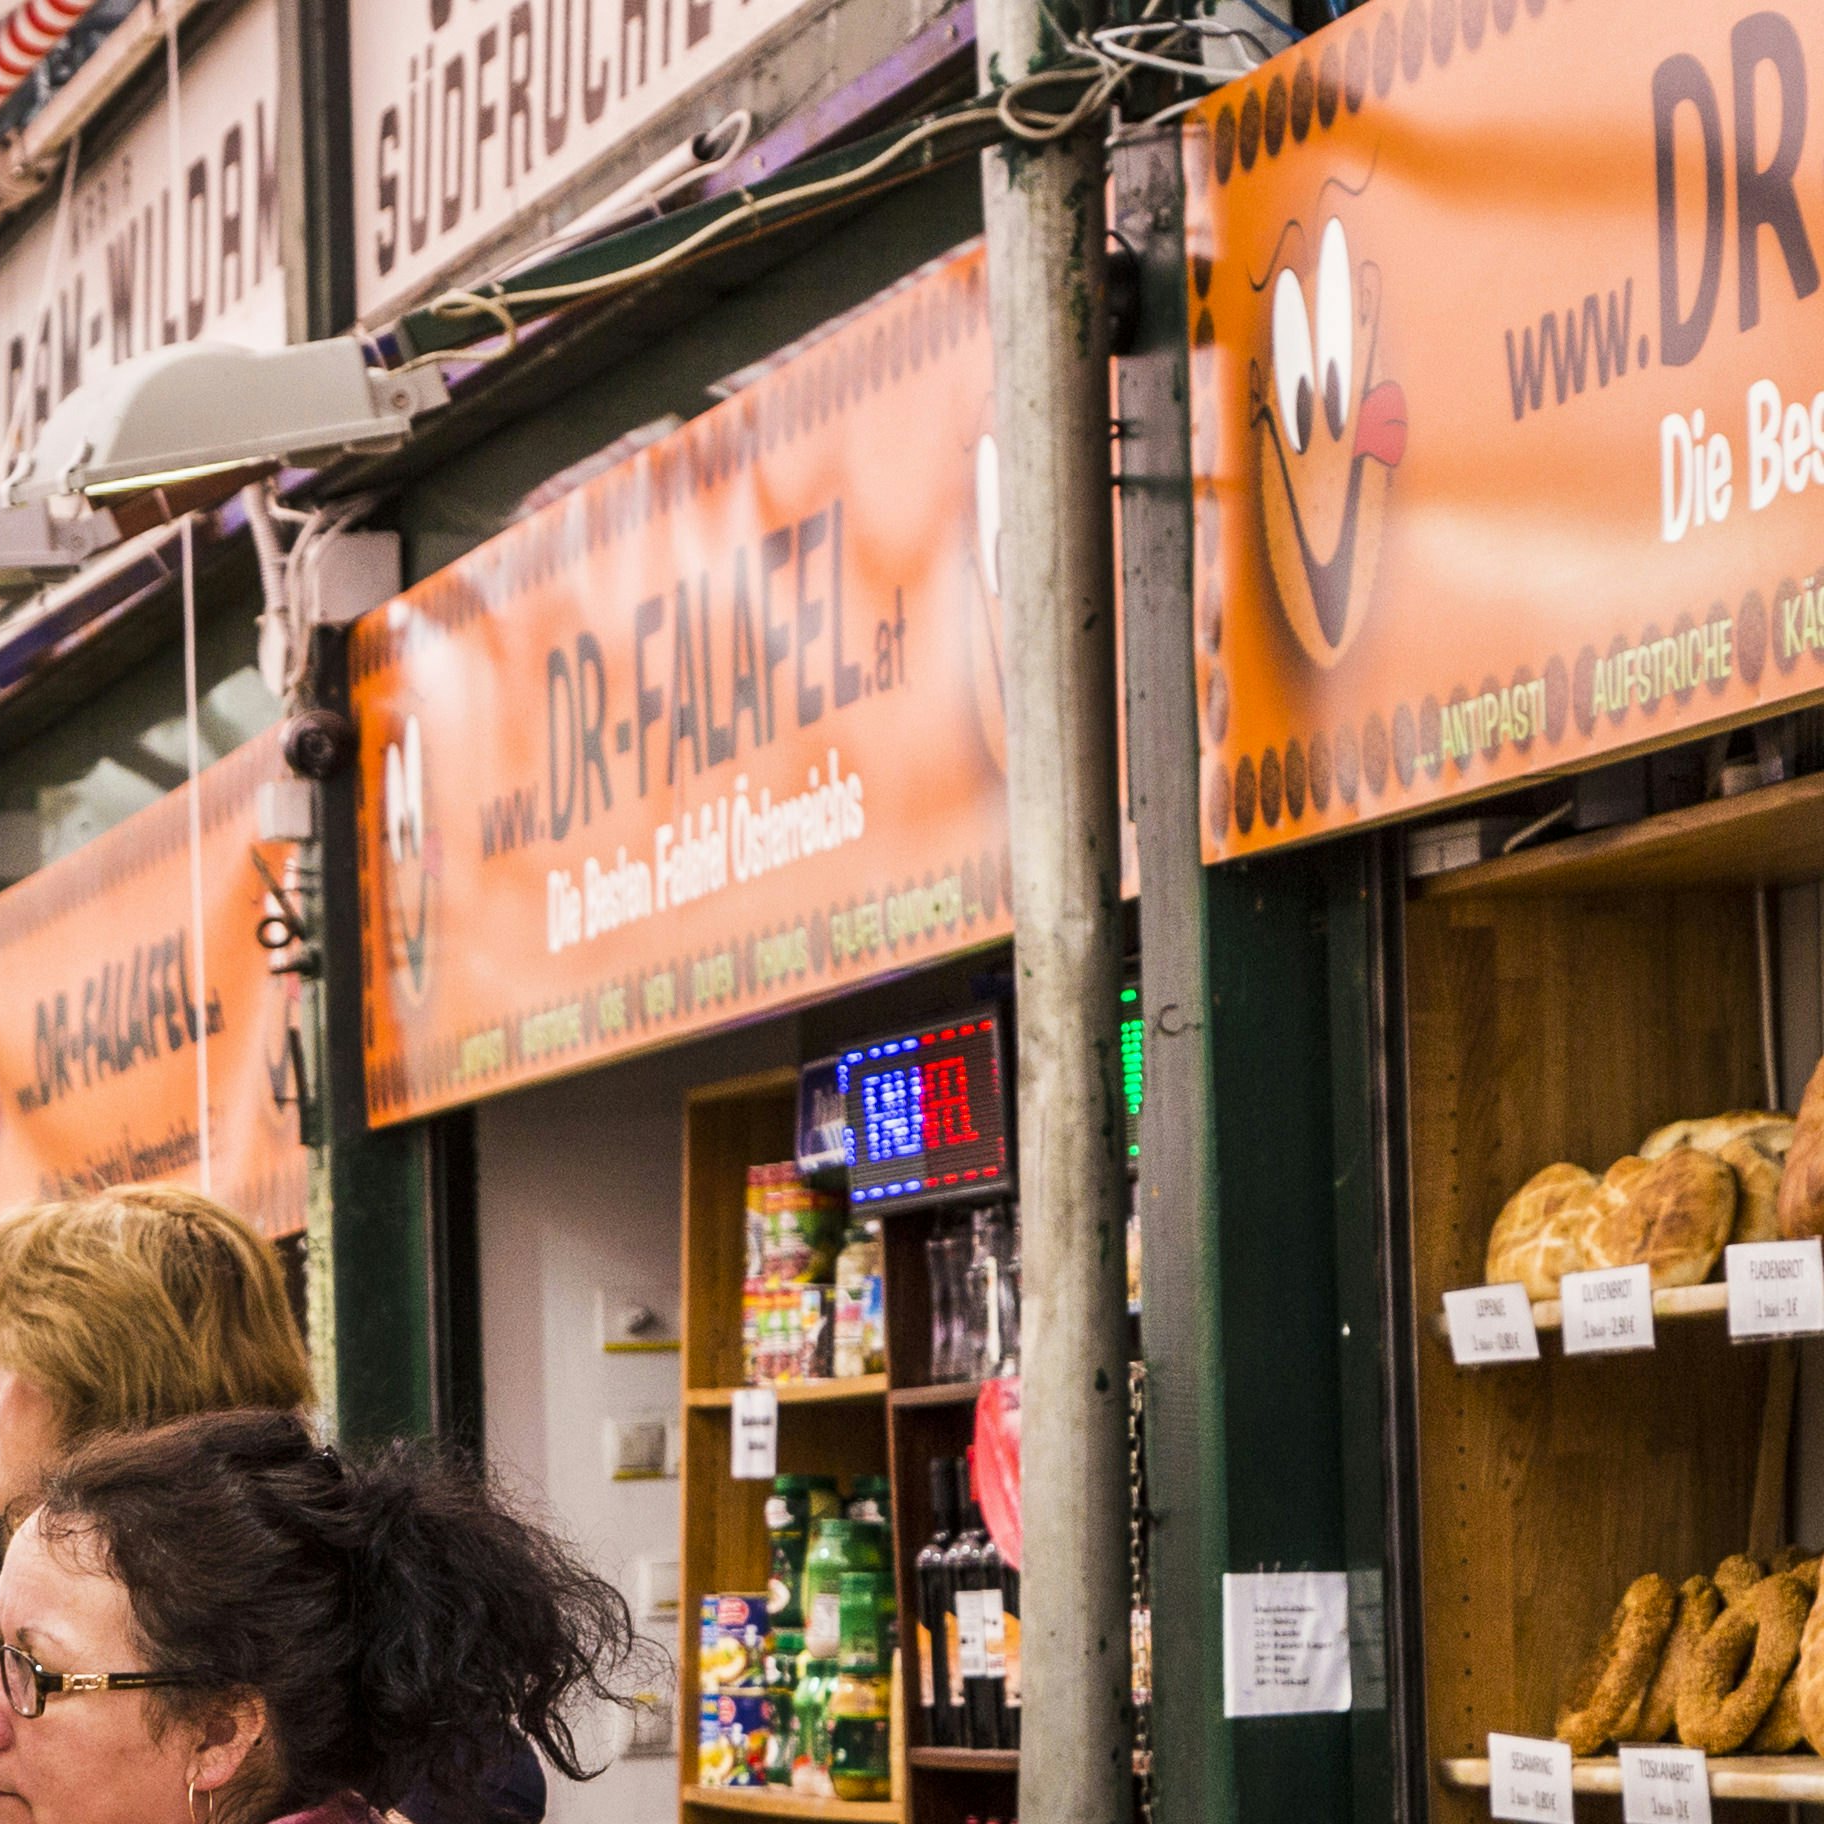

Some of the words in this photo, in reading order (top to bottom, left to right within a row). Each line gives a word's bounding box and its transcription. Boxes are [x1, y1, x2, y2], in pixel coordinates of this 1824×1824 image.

[1659, 408, 1733, 543] Die
[1441, 677, 1547, 760] ANTIPASTI
[1592, 617, 1734, 718] AUFSTRICHE
[547, 868, 582, 953] Die
